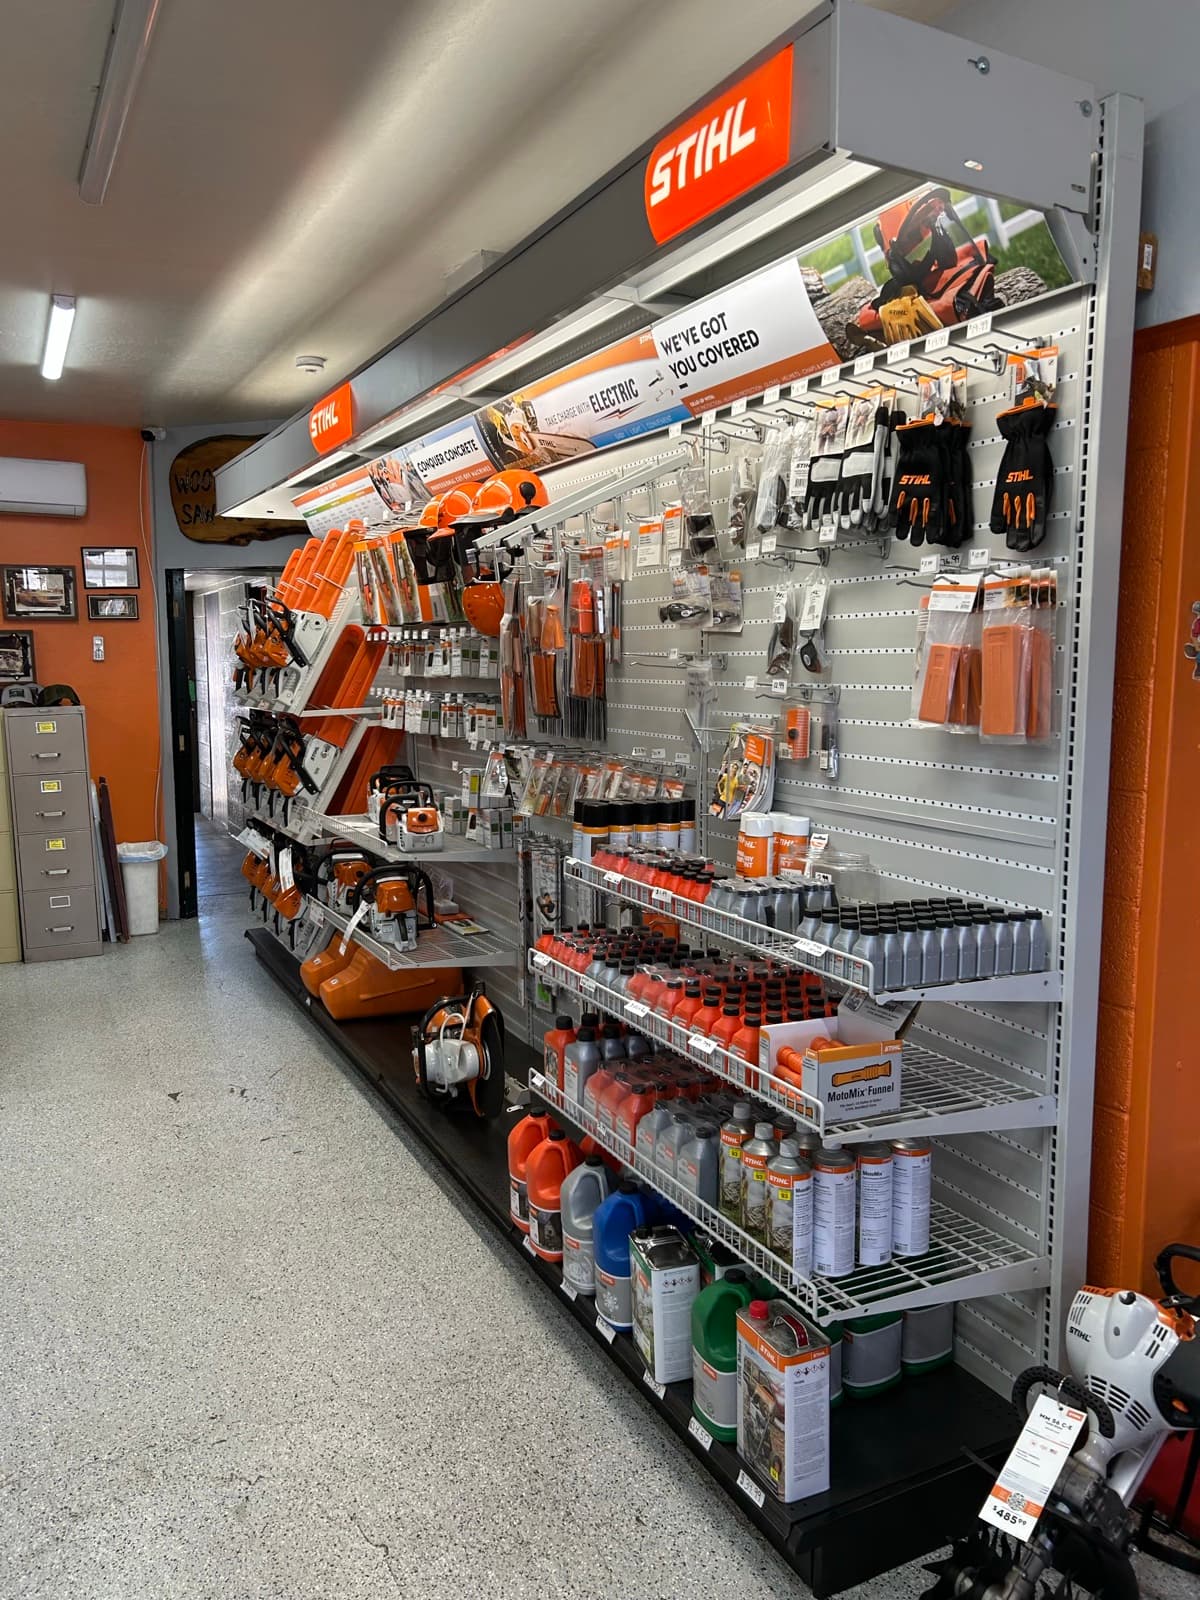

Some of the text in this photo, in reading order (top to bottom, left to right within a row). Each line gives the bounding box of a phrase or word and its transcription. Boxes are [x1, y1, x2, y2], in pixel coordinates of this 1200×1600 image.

[650, 97, 755, 207] STIHL
[660, 312, 728, 356] WE'VE GOT
[669, 329, 760, 379] YOU COVERED
[545, 378, 639, 425] TAKE CHARGE WITH ELECTRIC
[311, 403, 339, 439] STIHL
[417, 452, 445, 473] CONQUER
[445, 439, 479, 462] CONCRETE
[175, 469, 213, 495] WOO
[898, 474, 931, 485] STIHL
[1005, 469, 1034, 483] STIHL
[868, 1082, 895, 1096] Funnel
[722, 1134, 738, 1143] STIHL
[745, 1156, 763, 1167] STIHL
[769, 1175, 789, 1185] STIHL
[1069, 1326, 1092, 1342] STIHL
[760, 1344, 777, 1364] STIHL
